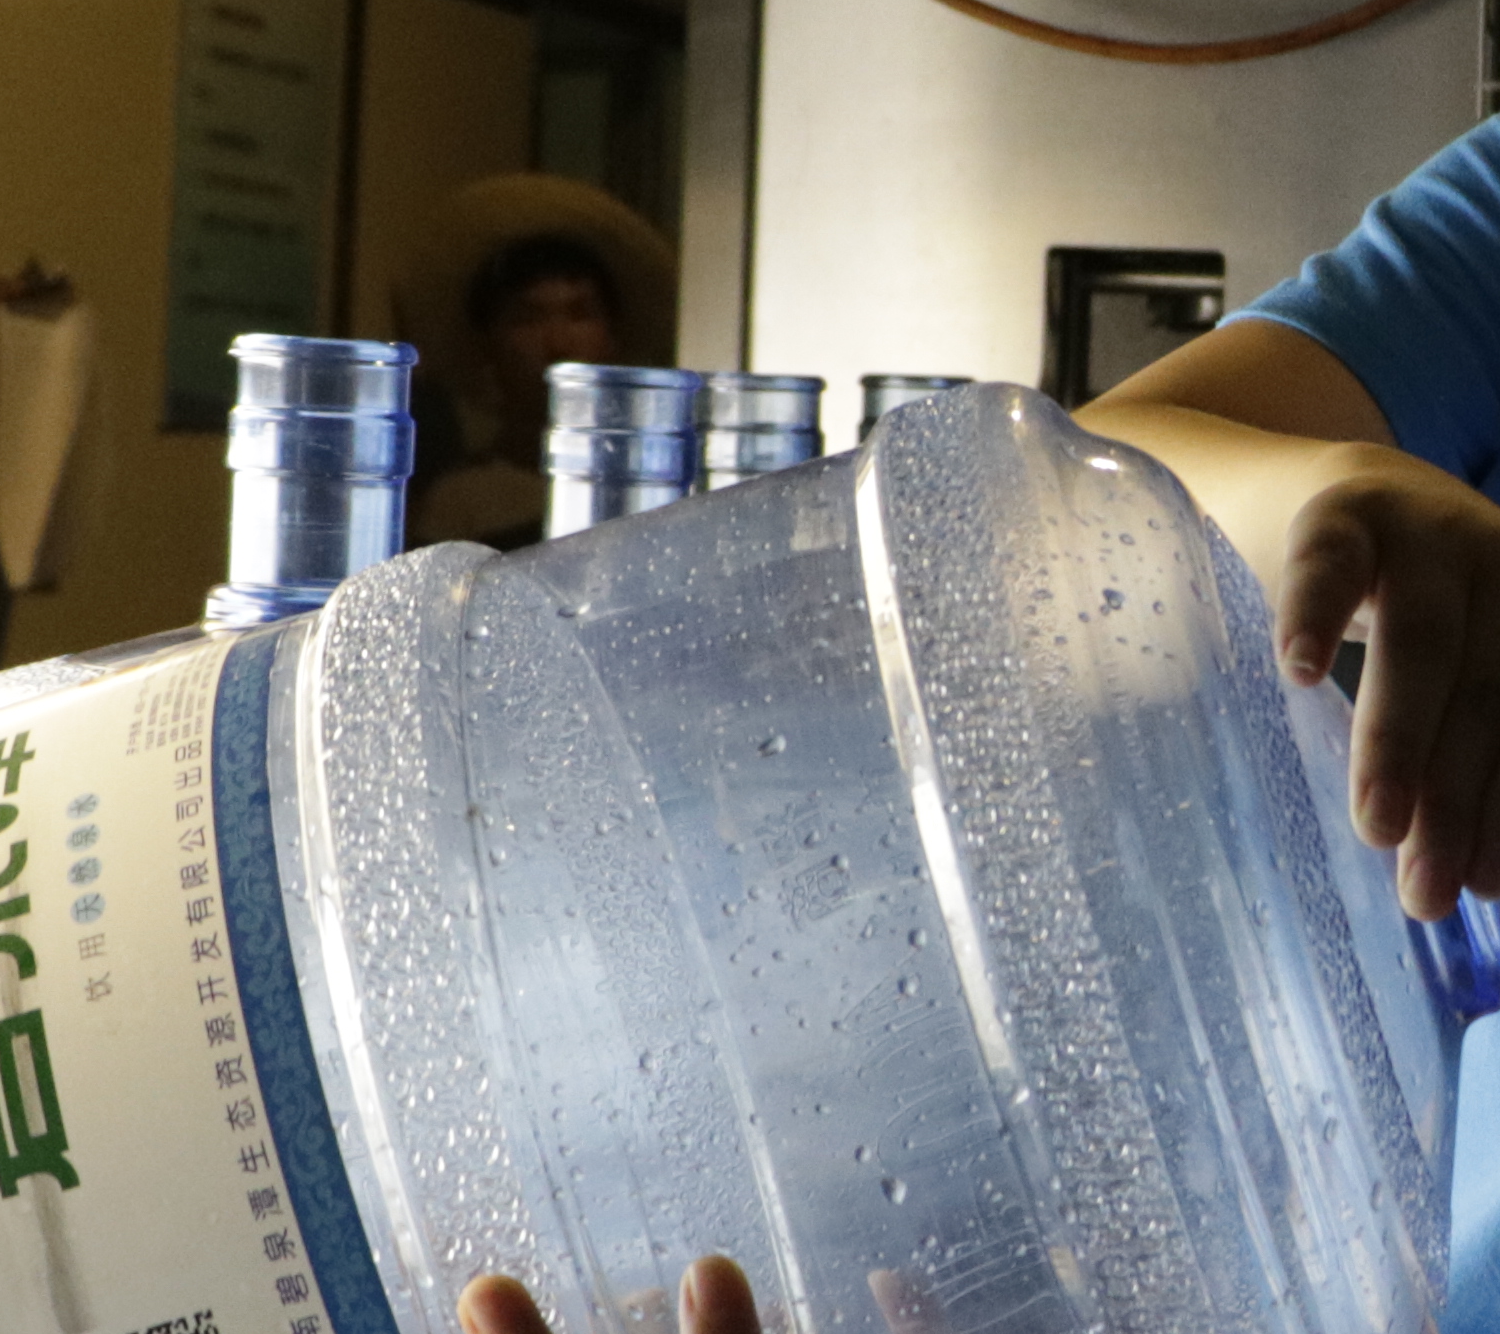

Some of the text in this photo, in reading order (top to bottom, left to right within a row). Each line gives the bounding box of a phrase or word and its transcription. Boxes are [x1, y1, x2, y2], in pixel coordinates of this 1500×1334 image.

[67, 794, 114, 1003] 饮用天然泉水
